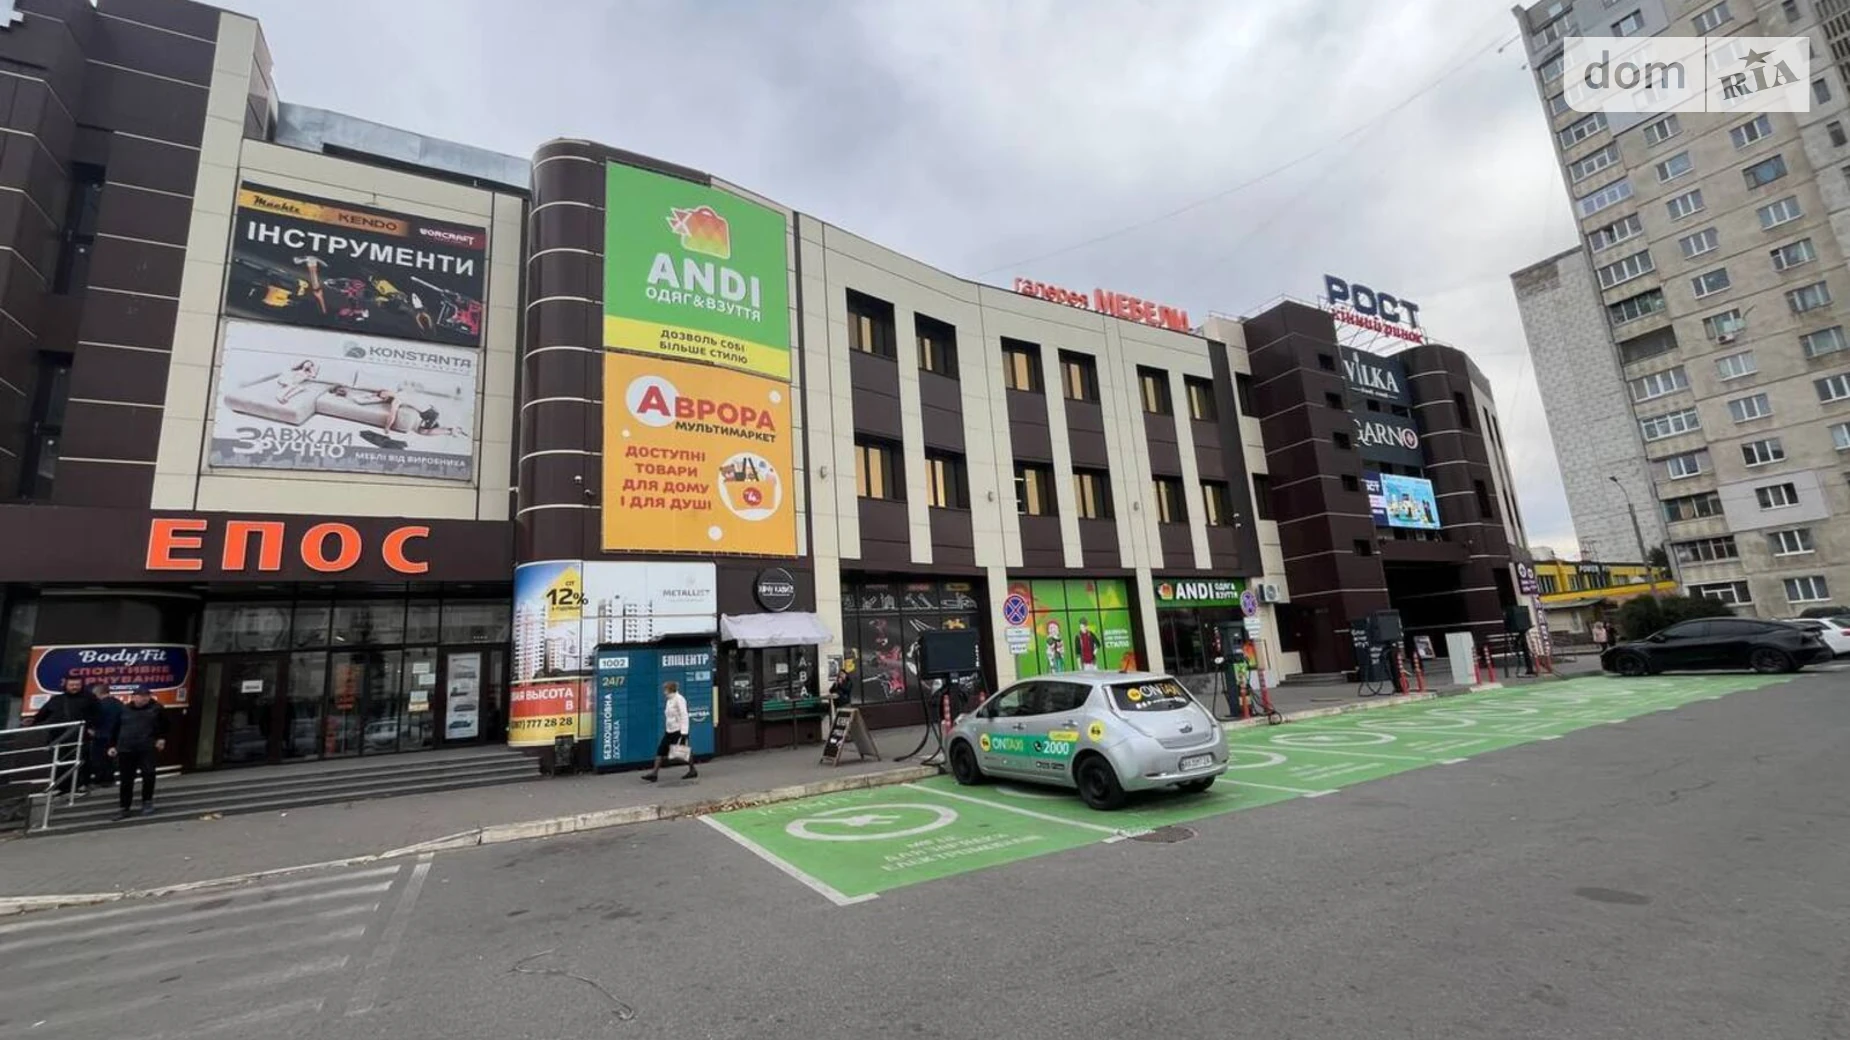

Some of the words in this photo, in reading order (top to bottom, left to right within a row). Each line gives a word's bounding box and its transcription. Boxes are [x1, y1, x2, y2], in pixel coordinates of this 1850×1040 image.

[338, 213, 398, 231] KENDO
[248, 221, 474, 277] ІНСТРУМЕНТИ
[647, 252, 761, 308] ANDI
[1324, 274, 1419, 329] РОСТ
[660, 329, 718, 346] ДОЗВОЛЬ
[720, 338, 745, 352] СОБІ
[370, 346, 471, 368] KONSTANTA
[659, 341, 707, 356] БІЛЬШЕ
[710, 349, 748, 364] СТИЛЮ
[674, 421, 777, 443] МУЛЬТИМАРКЕТ
[355, 451, 387, 461] МЕБЛІ
[407, 456, 466, 468] ВИРОБНИКА
[625, 445, 706, 462] ДОСТУПНІ
[635, 463, 698, 477] ТОВАРИ
[622, 479, 659, 491] ДЛЯ
[663, 480, 710, 494] ДОМУ
[629, 496, 665, 509] ДЛЯ
[670, 498, 712, 511] ДУШІ
[146, 518, 430, 574] ЕПОС
[546, 587, 589, 606] 12%
[1176, 583, 1215, 600] ANDI
[601, 658, 626, 667] 1002
[602, 676, 625, 687] 24/7
[525, 687, 574, 701] ВЫСОТА
[565, 700, 574, 711] В
[544, 718, 558, 728] 28
[559, 716, 573, 726] 28
[603, 693, 612, 760] БЕЗКОШТОВНА
[1043, 740, 1070, 755] 2000
